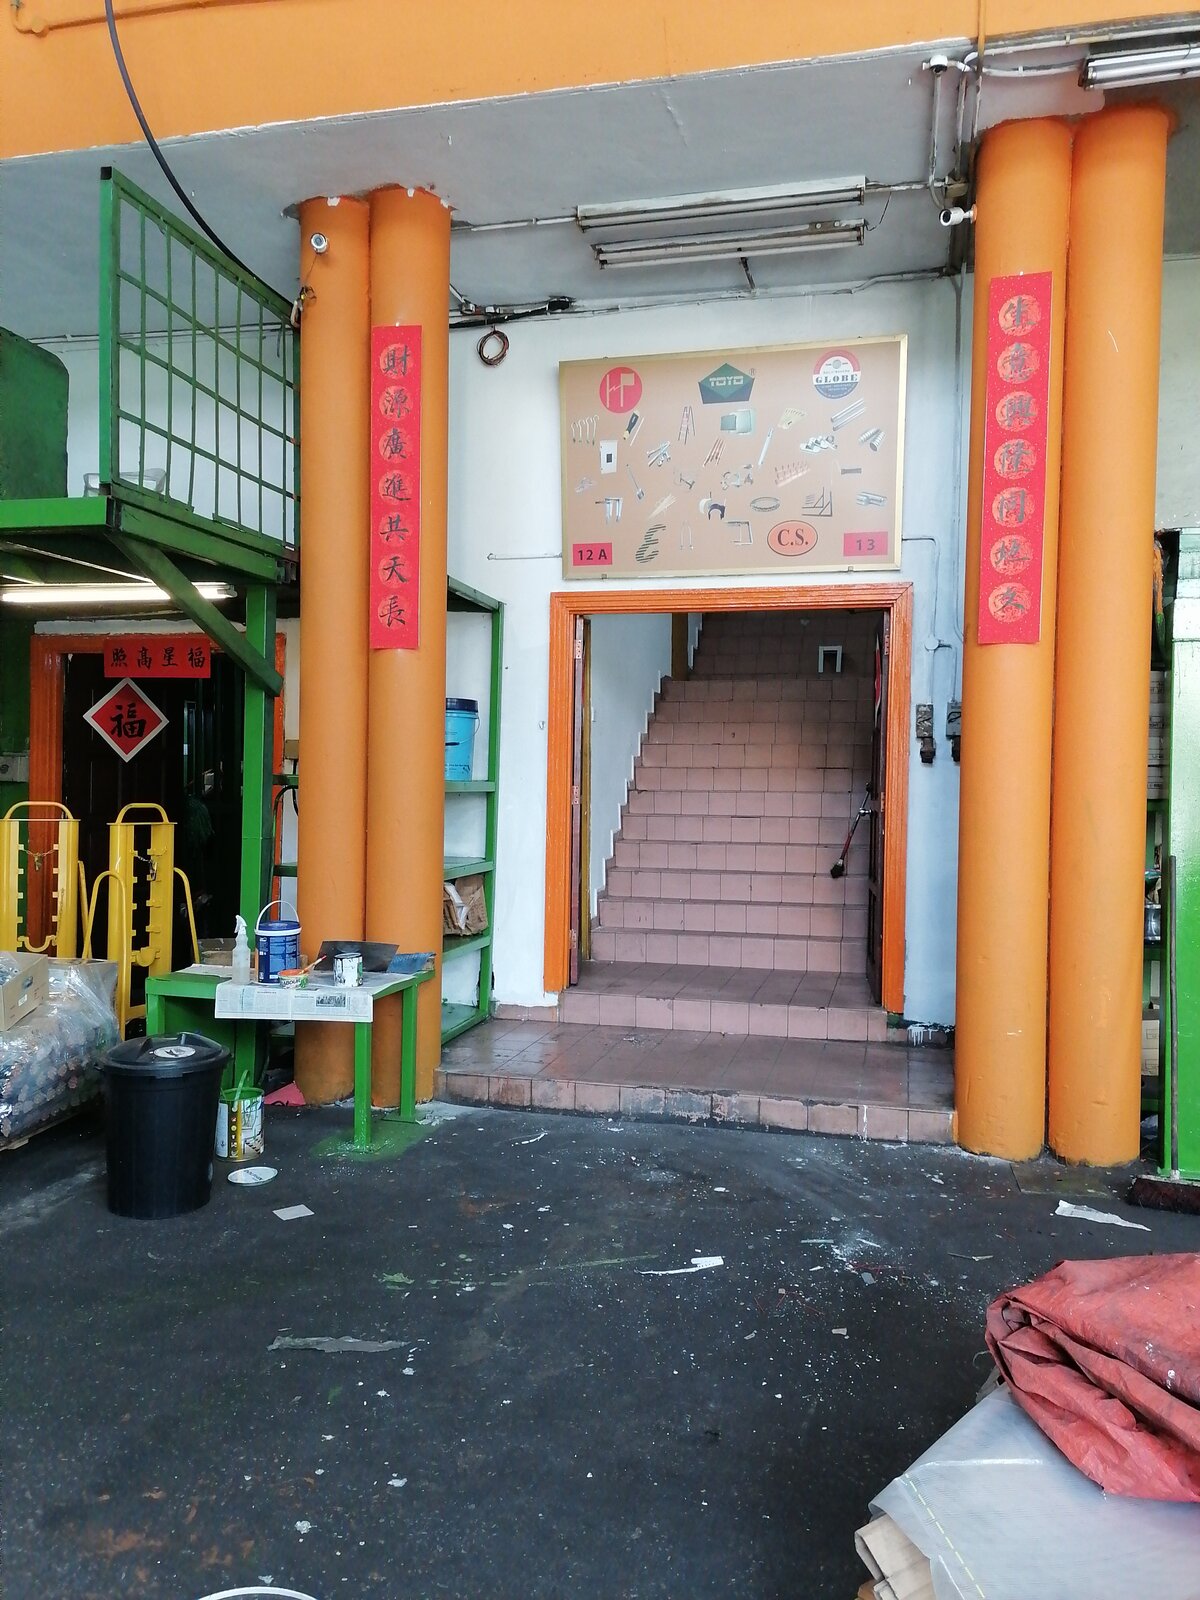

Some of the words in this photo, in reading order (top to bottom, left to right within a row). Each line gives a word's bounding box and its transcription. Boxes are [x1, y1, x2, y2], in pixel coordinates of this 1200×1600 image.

[709, 375, 744, 387] TOYO
[815, 374, 858, 383] GLOBE
[379, 345, 411, 627] 財源廣進共天長
[777, 528, 809, 546] C.S.
[856, 539, 875, 551] 13
[110, 702, 146, 738] 福
